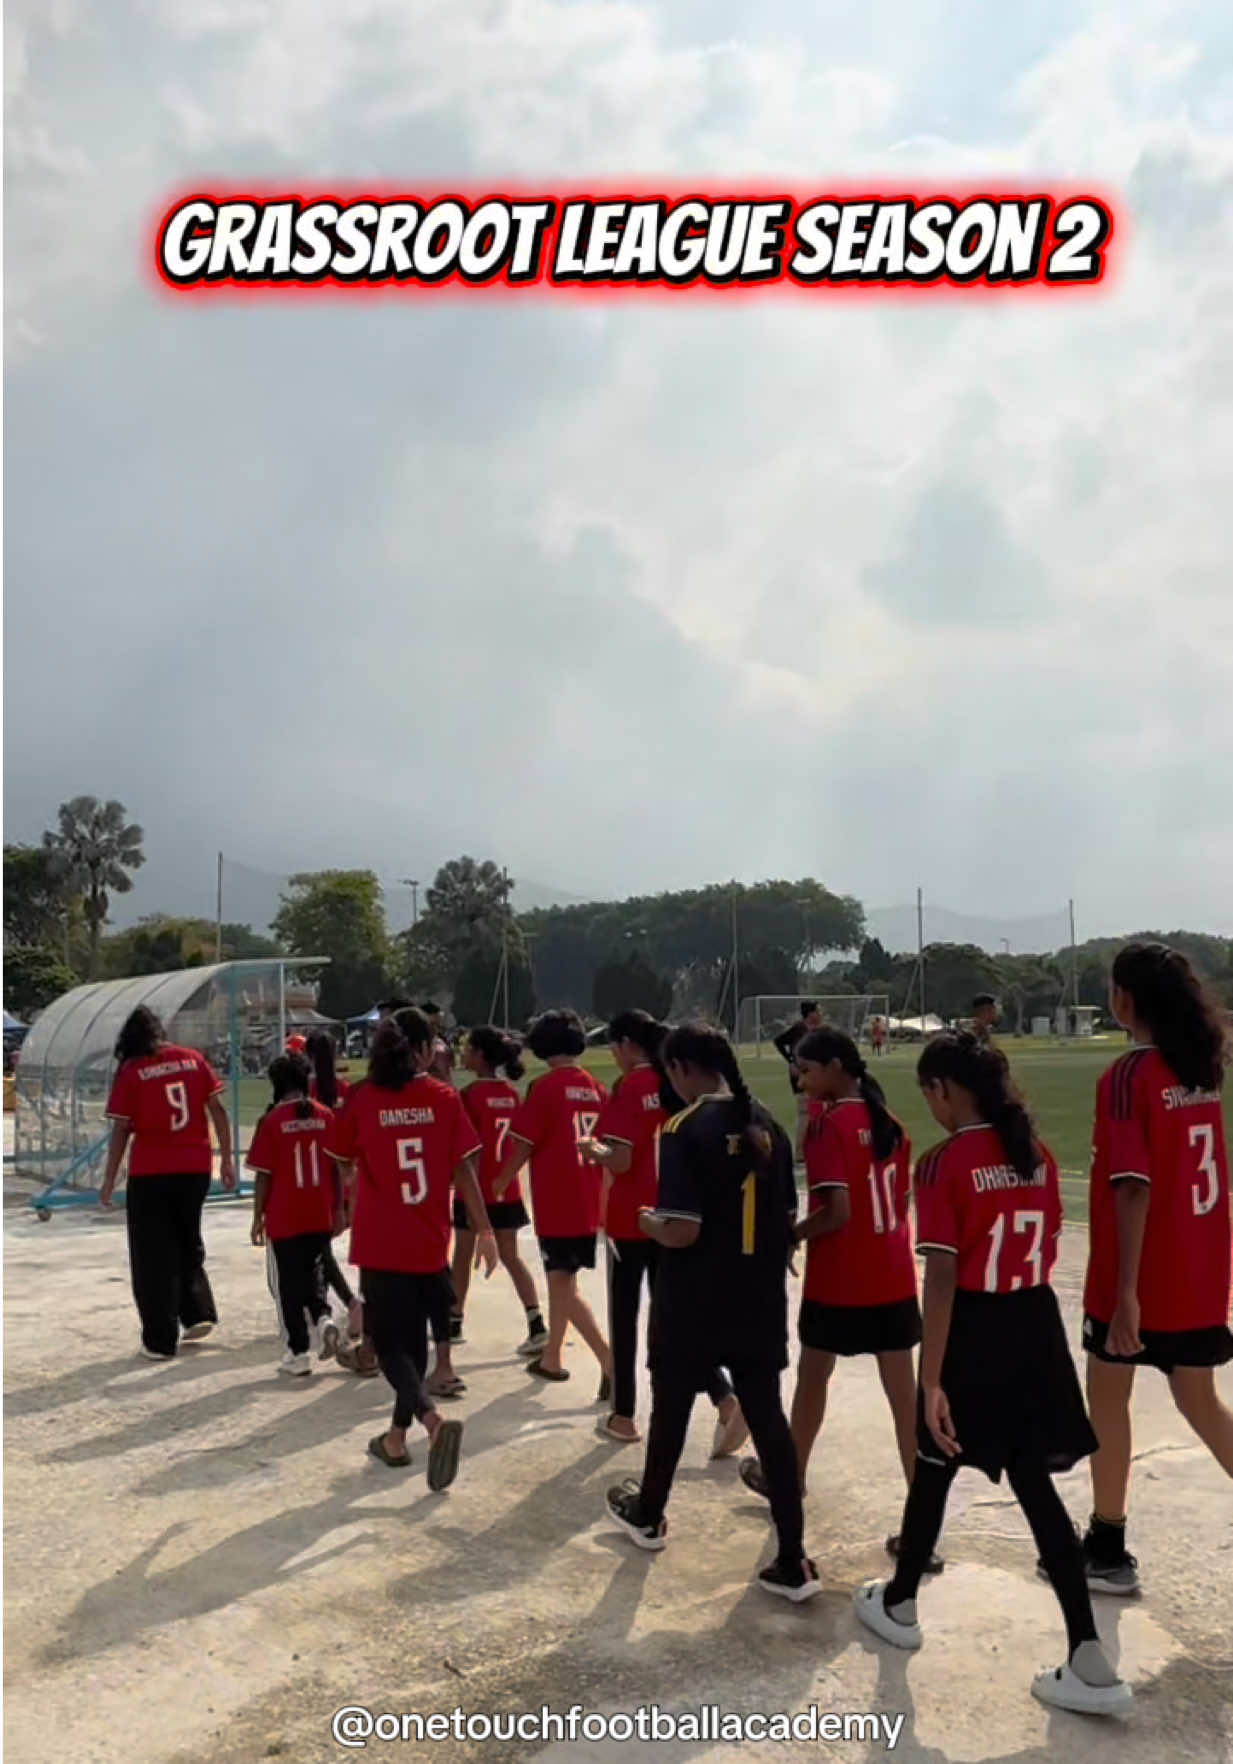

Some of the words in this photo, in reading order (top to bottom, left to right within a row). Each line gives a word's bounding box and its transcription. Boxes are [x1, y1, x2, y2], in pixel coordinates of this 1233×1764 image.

[165, 1081, 189, 1131] 9
[495, 1117, 511, 1162] 7
[293, 1139, 320, 1188] 11
[396, 1137, 428, 1205] 5
[1188, 1122, 1219, 1215] 3
[740, 1169, 756, 1255] 1
[984, 1210, 1044, 1292] 13
